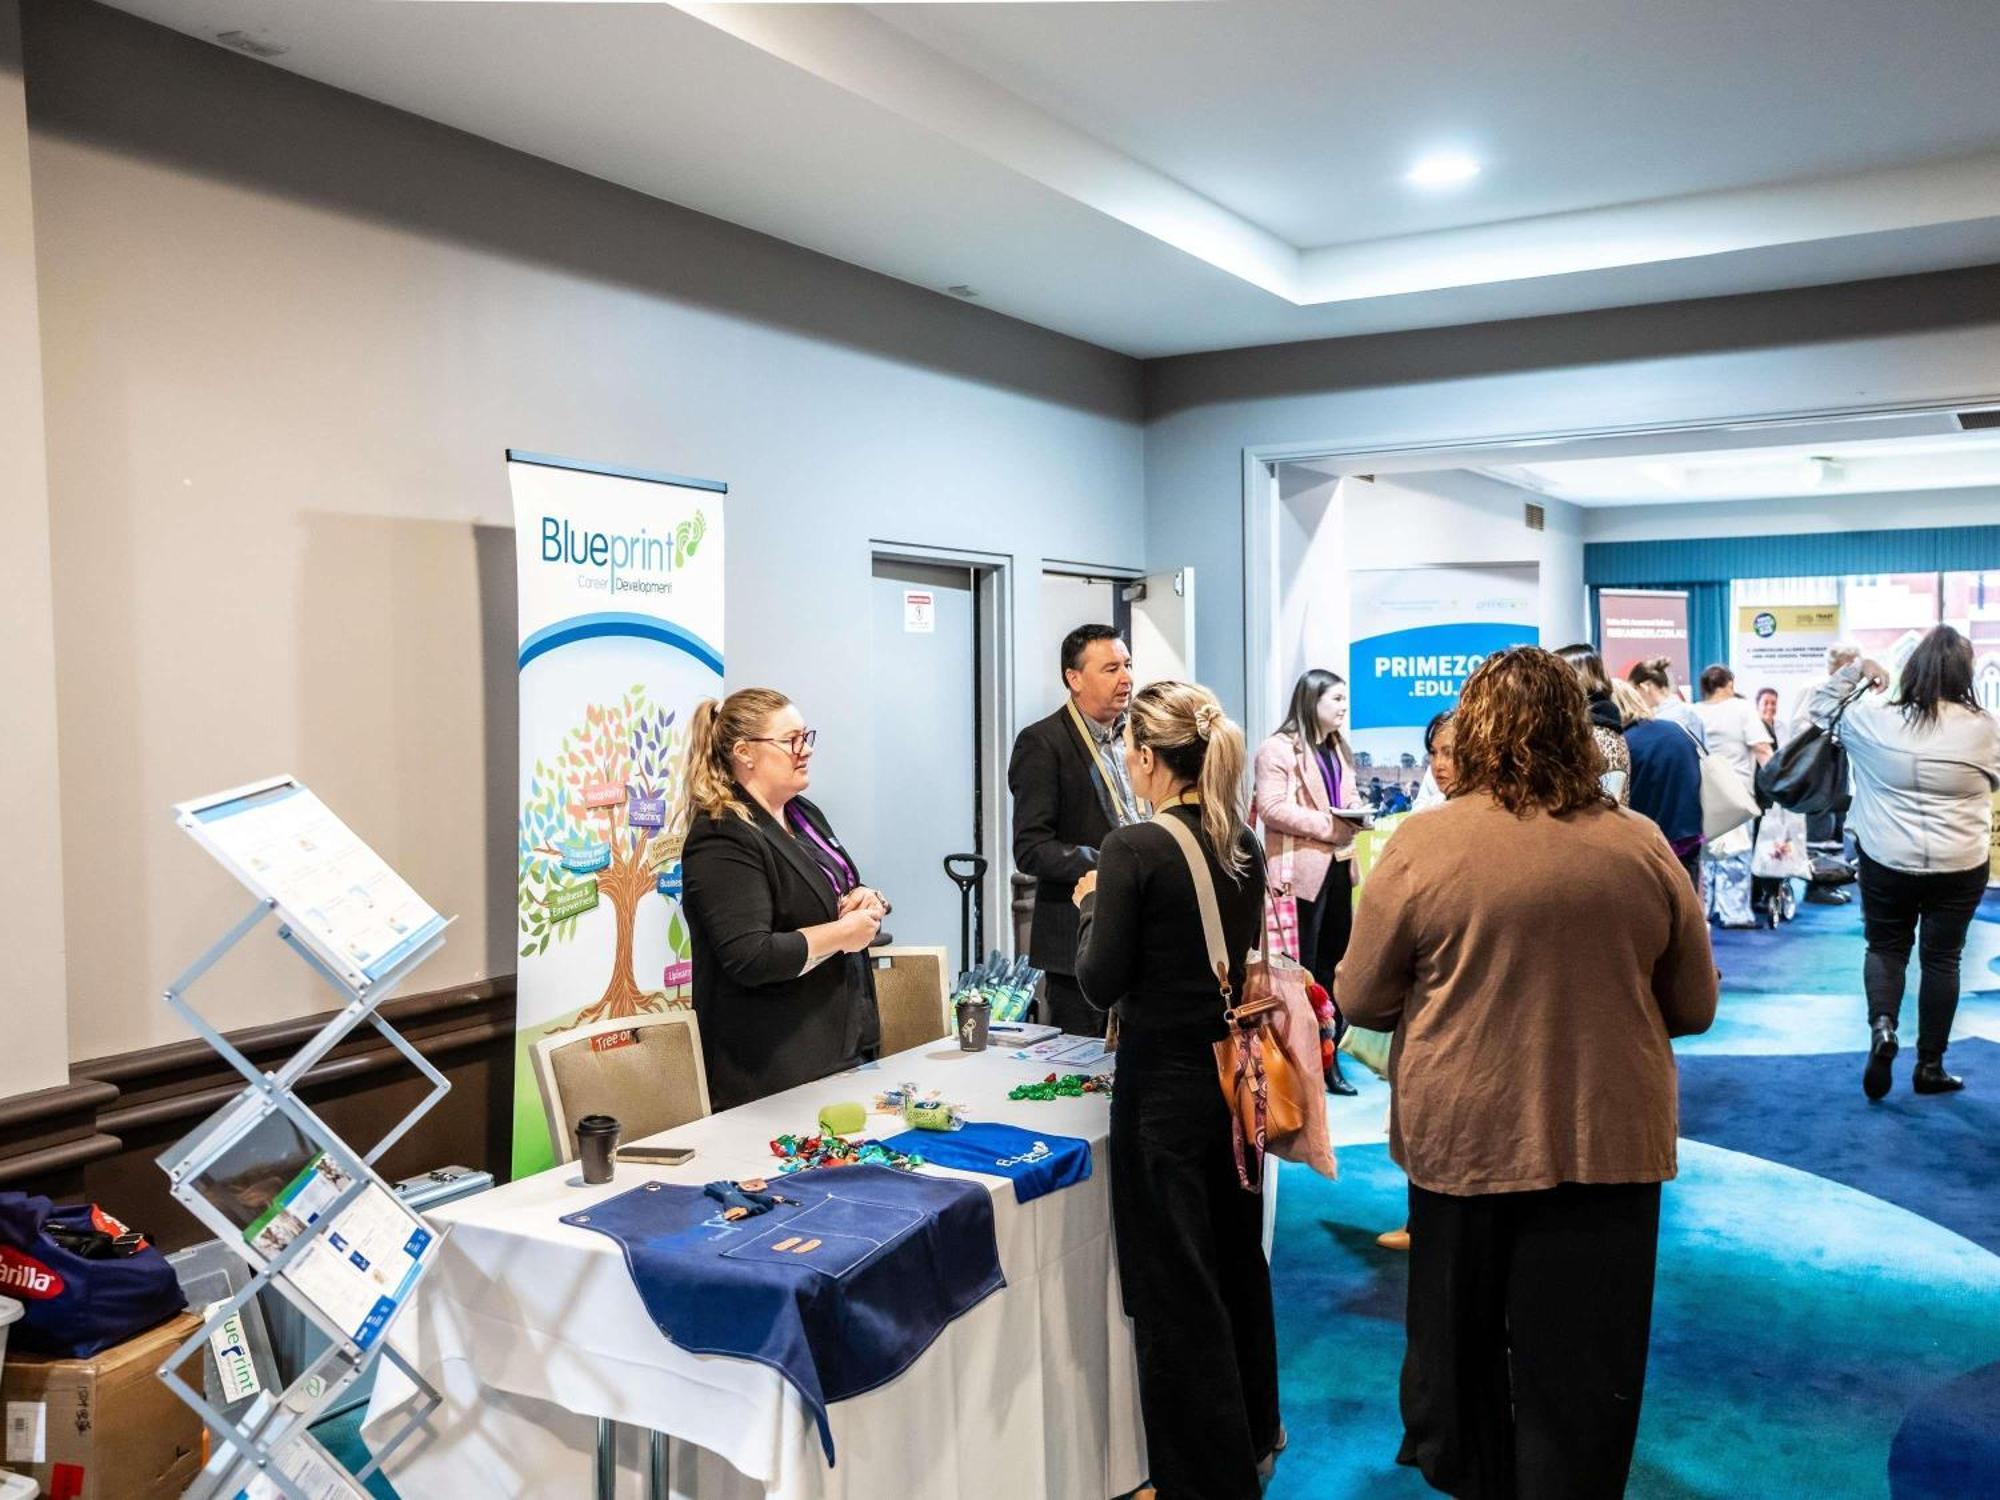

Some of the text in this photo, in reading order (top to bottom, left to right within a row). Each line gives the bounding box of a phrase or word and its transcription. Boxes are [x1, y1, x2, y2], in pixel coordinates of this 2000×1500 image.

[542, 516, 674, 594] Blueprint
[615, 577, 672, 594] Development
[596, 1032, 619, 1051] Tree
